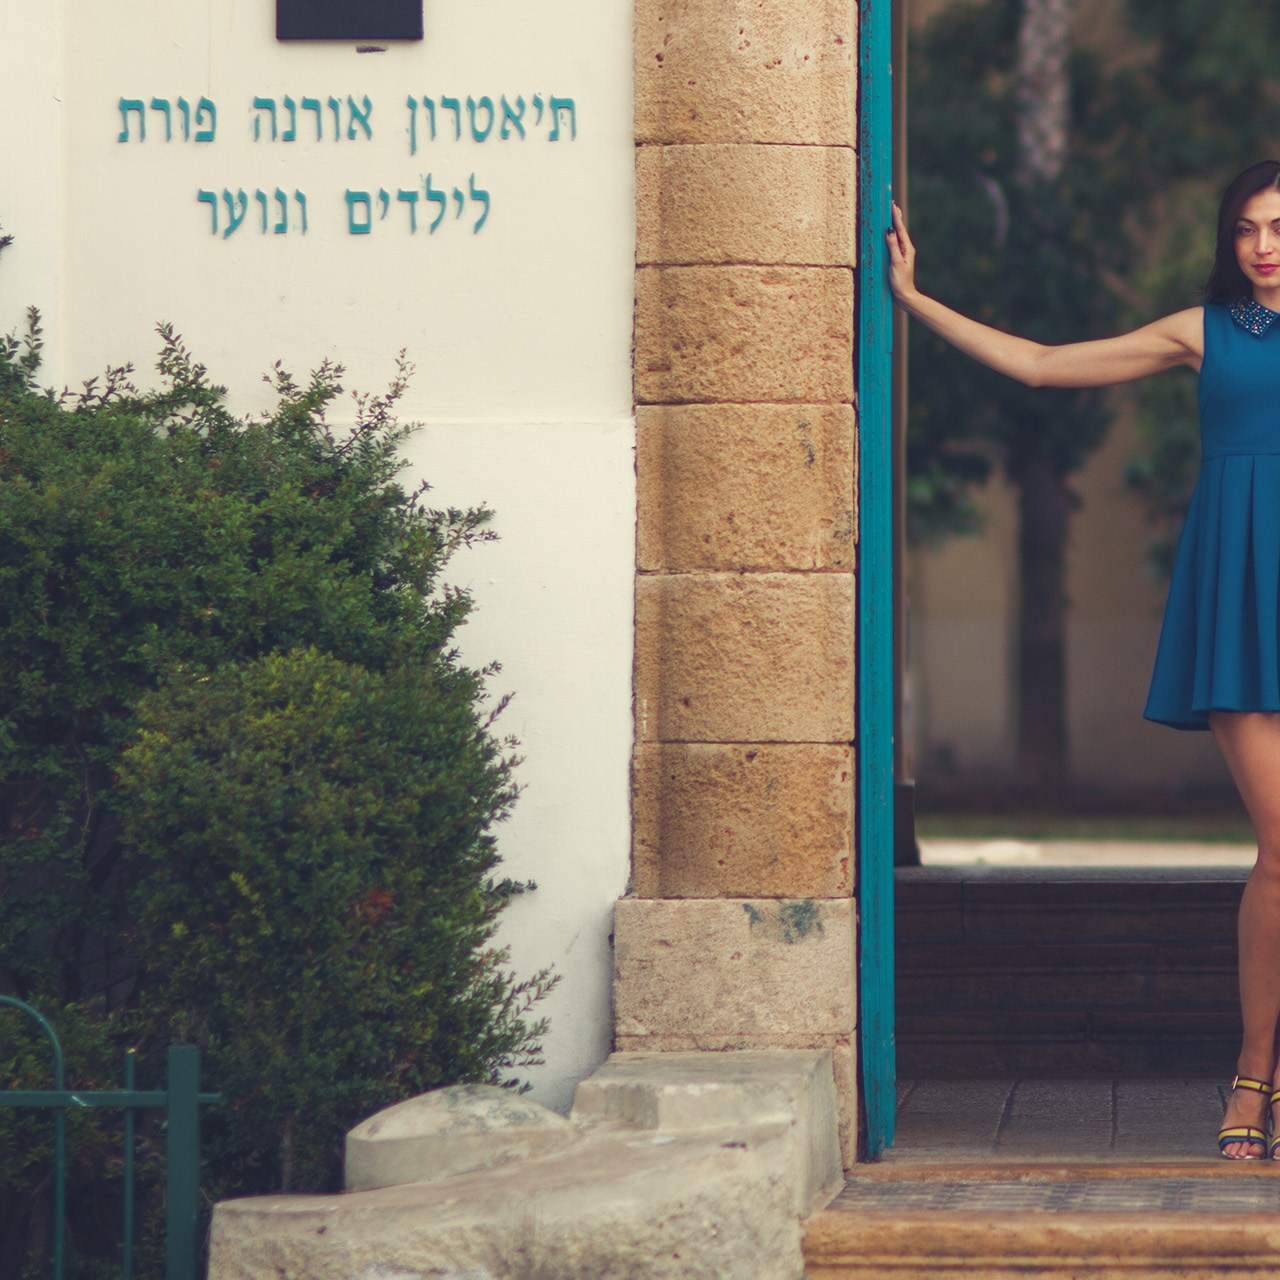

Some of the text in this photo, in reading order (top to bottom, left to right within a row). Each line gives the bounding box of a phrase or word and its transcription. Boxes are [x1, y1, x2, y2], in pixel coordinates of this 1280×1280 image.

[118, 95, 577, 155] תיאטרון אורנה פורת
[197, 172, 491, 238] לילדים ונוער
